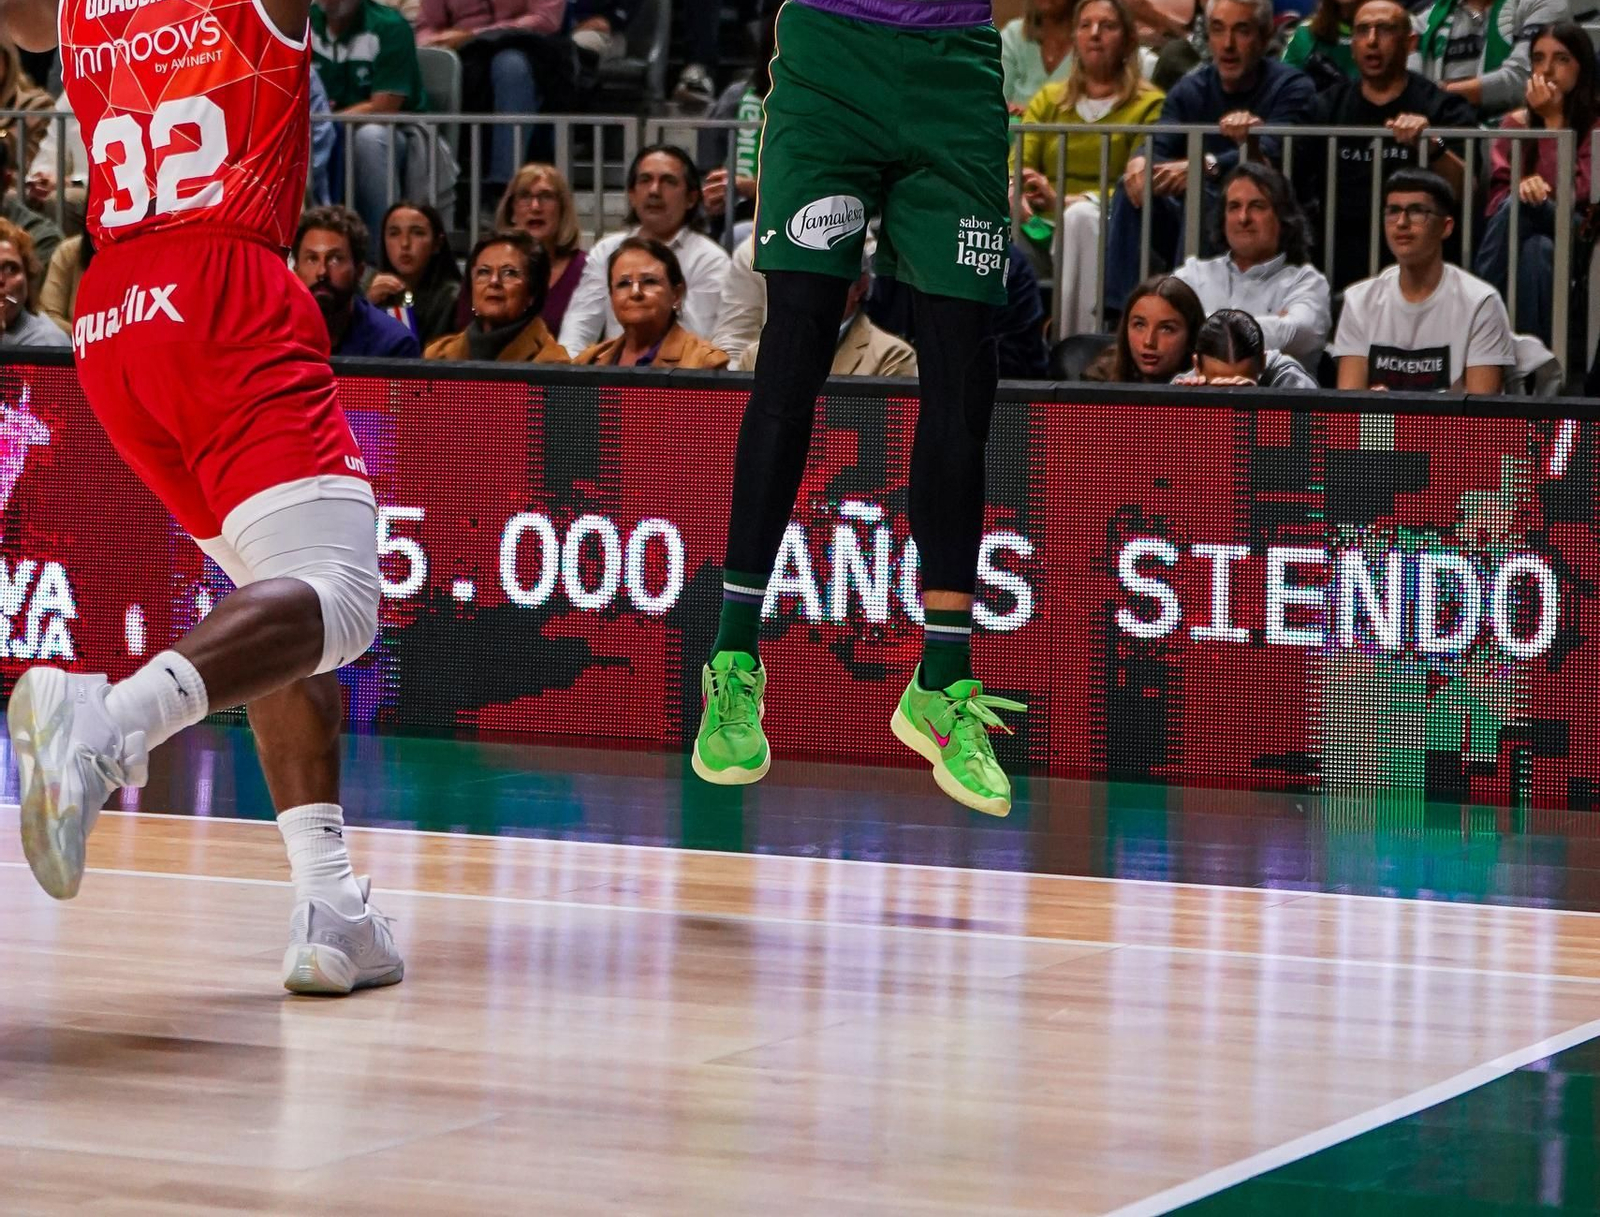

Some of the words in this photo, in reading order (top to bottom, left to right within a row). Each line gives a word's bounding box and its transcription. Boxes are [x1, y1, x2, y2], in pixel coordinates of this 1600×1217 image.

[154, 61, 168, 73] by
[171, 48, 223, 71] AVINENT
[91, 95, 229, 228] 32
[959, 214, 992, 230] sabor
[956, 241, 1001, 276] laga
[1376, 356, 1444, 374] MCKENZIE
[1105, 536, 1560, 659] SIENDO
